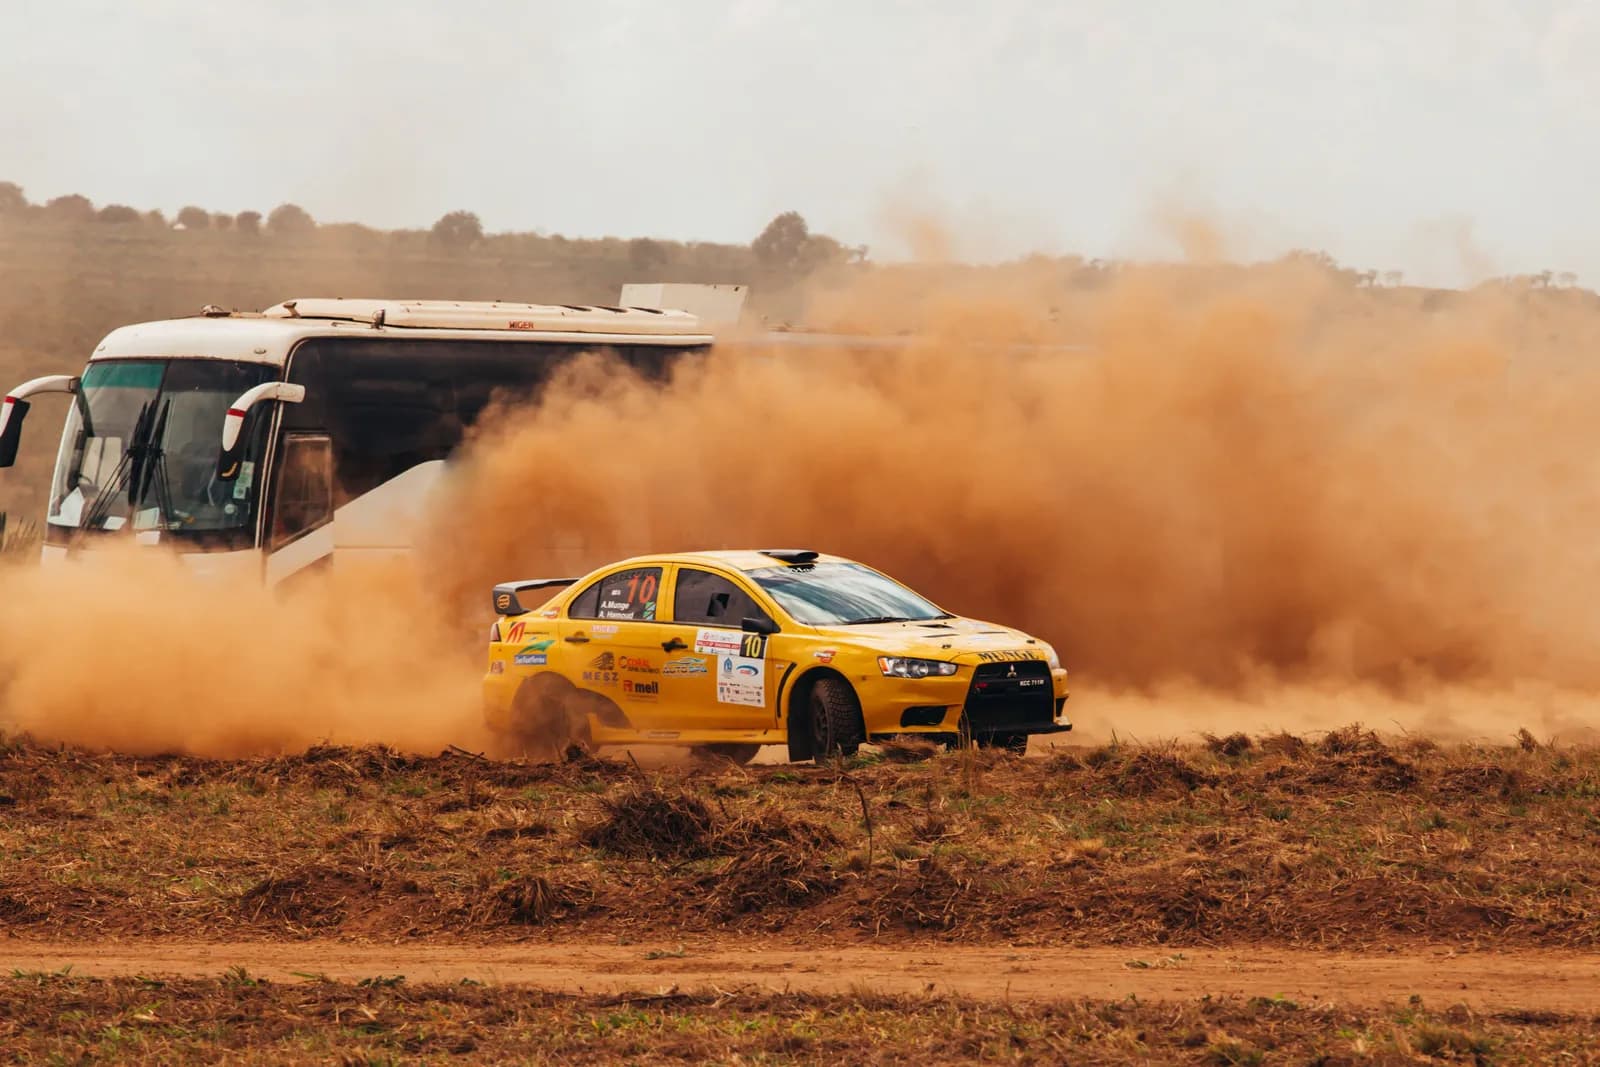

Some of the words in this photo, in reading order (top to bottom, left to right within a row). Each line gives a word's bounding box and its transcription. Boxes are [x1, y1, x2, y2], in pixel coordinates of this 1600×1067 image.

[627, 575, 656, 604] 10
[745, 635, 761, 657] 10
[978, 651, 1039, 661] MUNGE
[583, 672, 618, 681] MESZ
